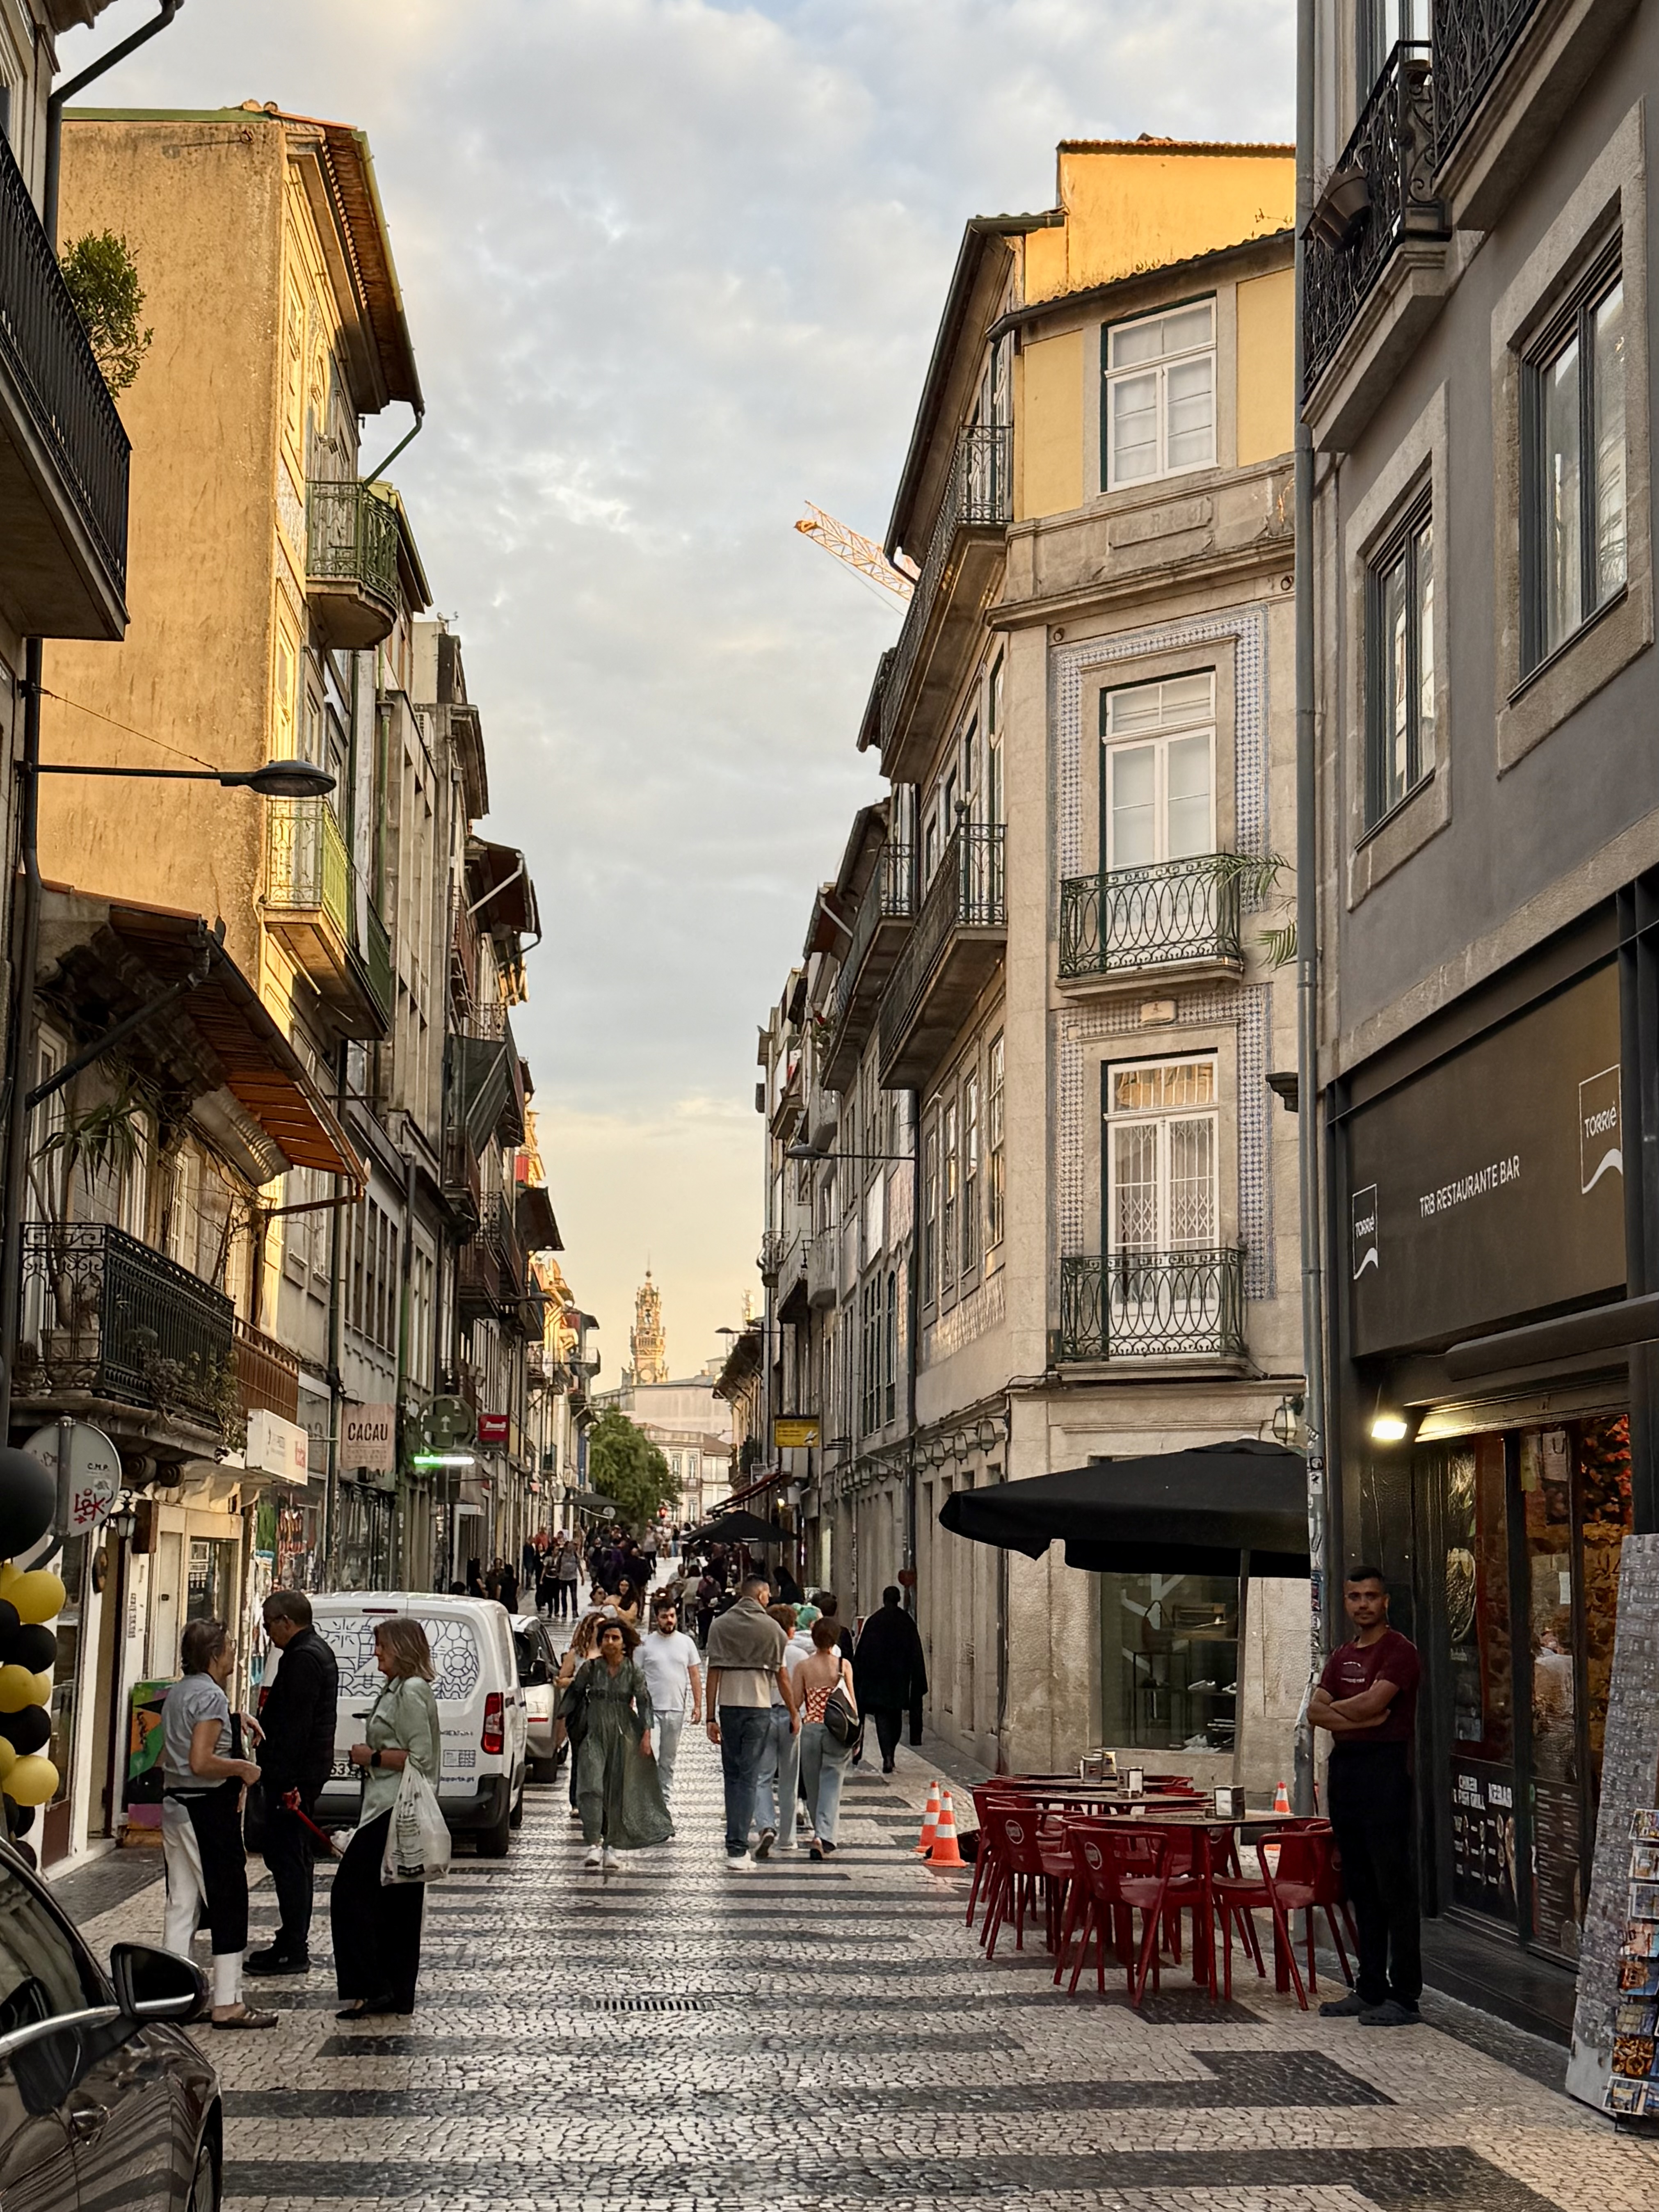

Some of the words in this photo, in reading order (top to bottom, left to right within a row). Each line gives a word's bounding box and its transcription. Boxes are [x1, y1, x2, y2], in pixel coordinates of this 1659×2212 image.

[1419, 1193, 1435, 1218] TRB
[1437, 1164, 1497, 1211] RESTAURANTE
[1500, 1155, 1520, 1184] BAR
[348, 1422, 388, 1441] CACAU
